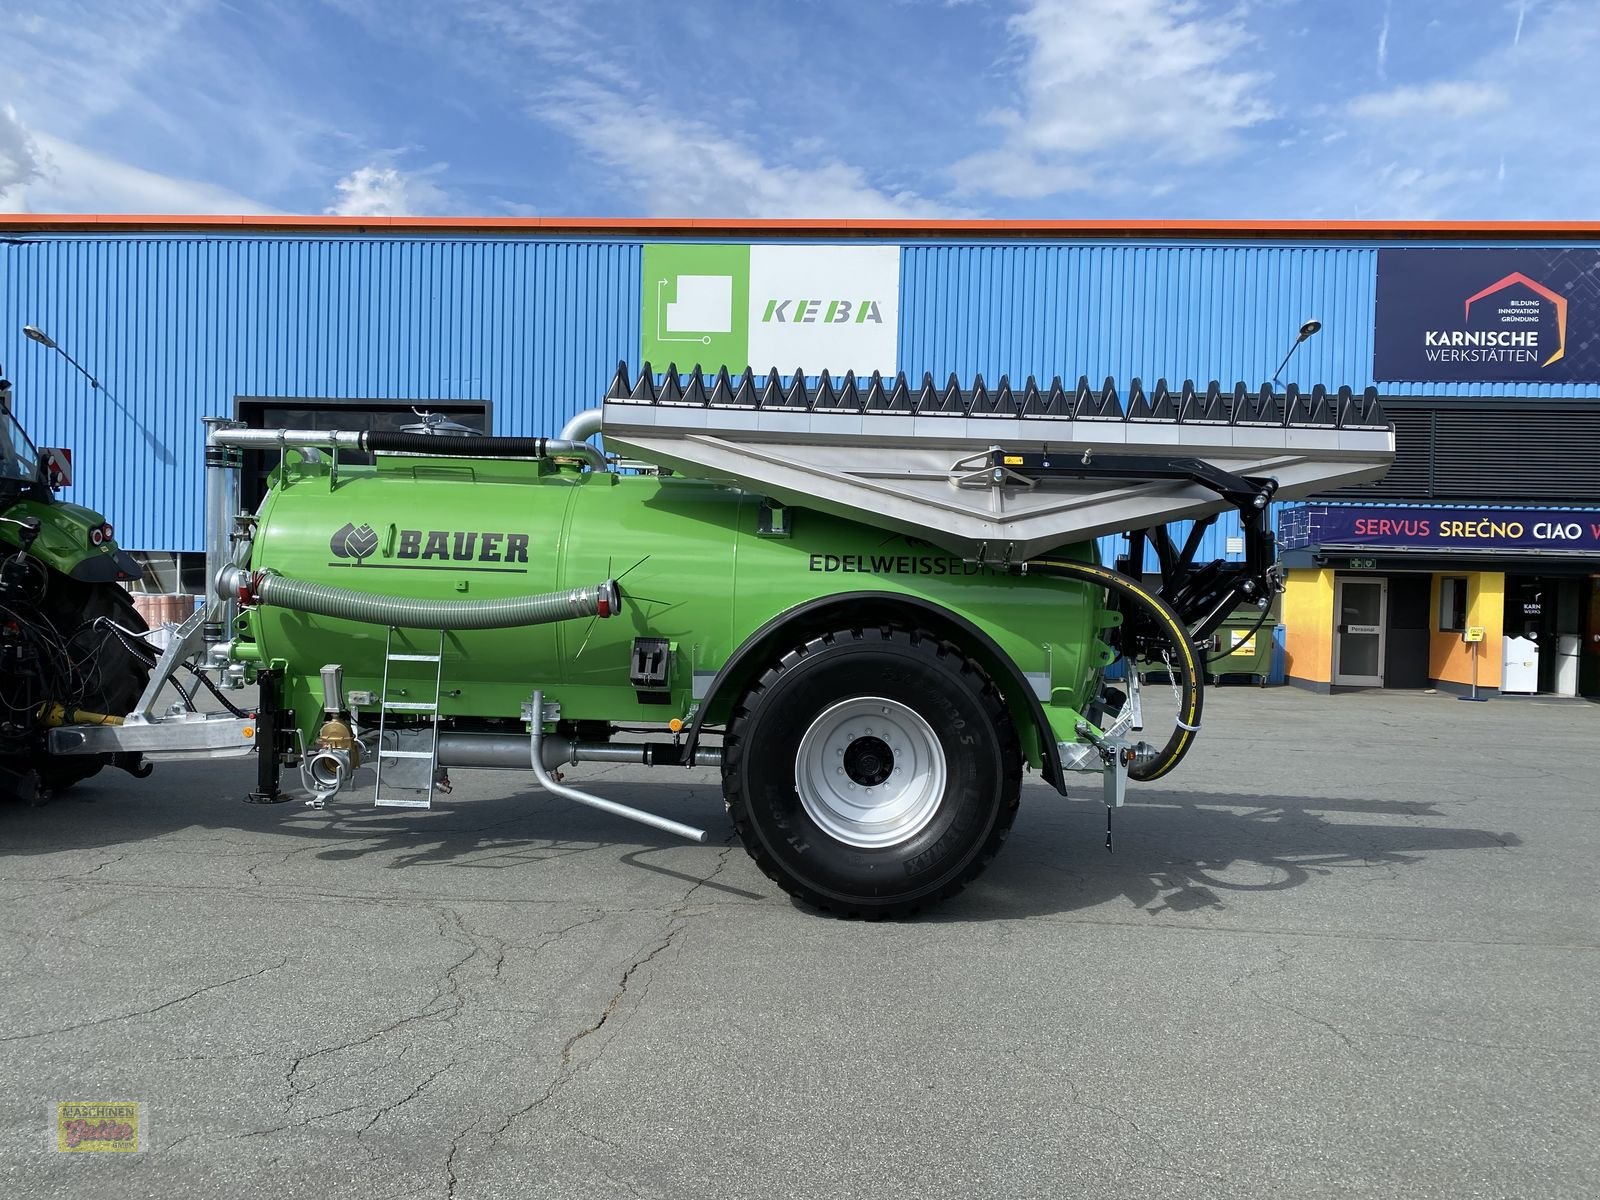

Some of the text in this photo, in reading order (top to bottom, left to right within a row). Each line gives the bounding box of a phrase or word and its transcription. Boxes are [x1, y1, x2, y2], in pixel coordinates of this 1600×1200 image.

[762, 299, 883, 324] KEBA
[1425, 331, 1538, 346] KARNISCHE
[1425, 348, 1538, 362] WERKSTÄTTEN
[1354, 519, 1430, 536] SERVUS
[1439, 518, 1524, 538] SREČNO
[1533, 523, 1582, 540] CIAO
[397, 530, 529, 562] BAUER
